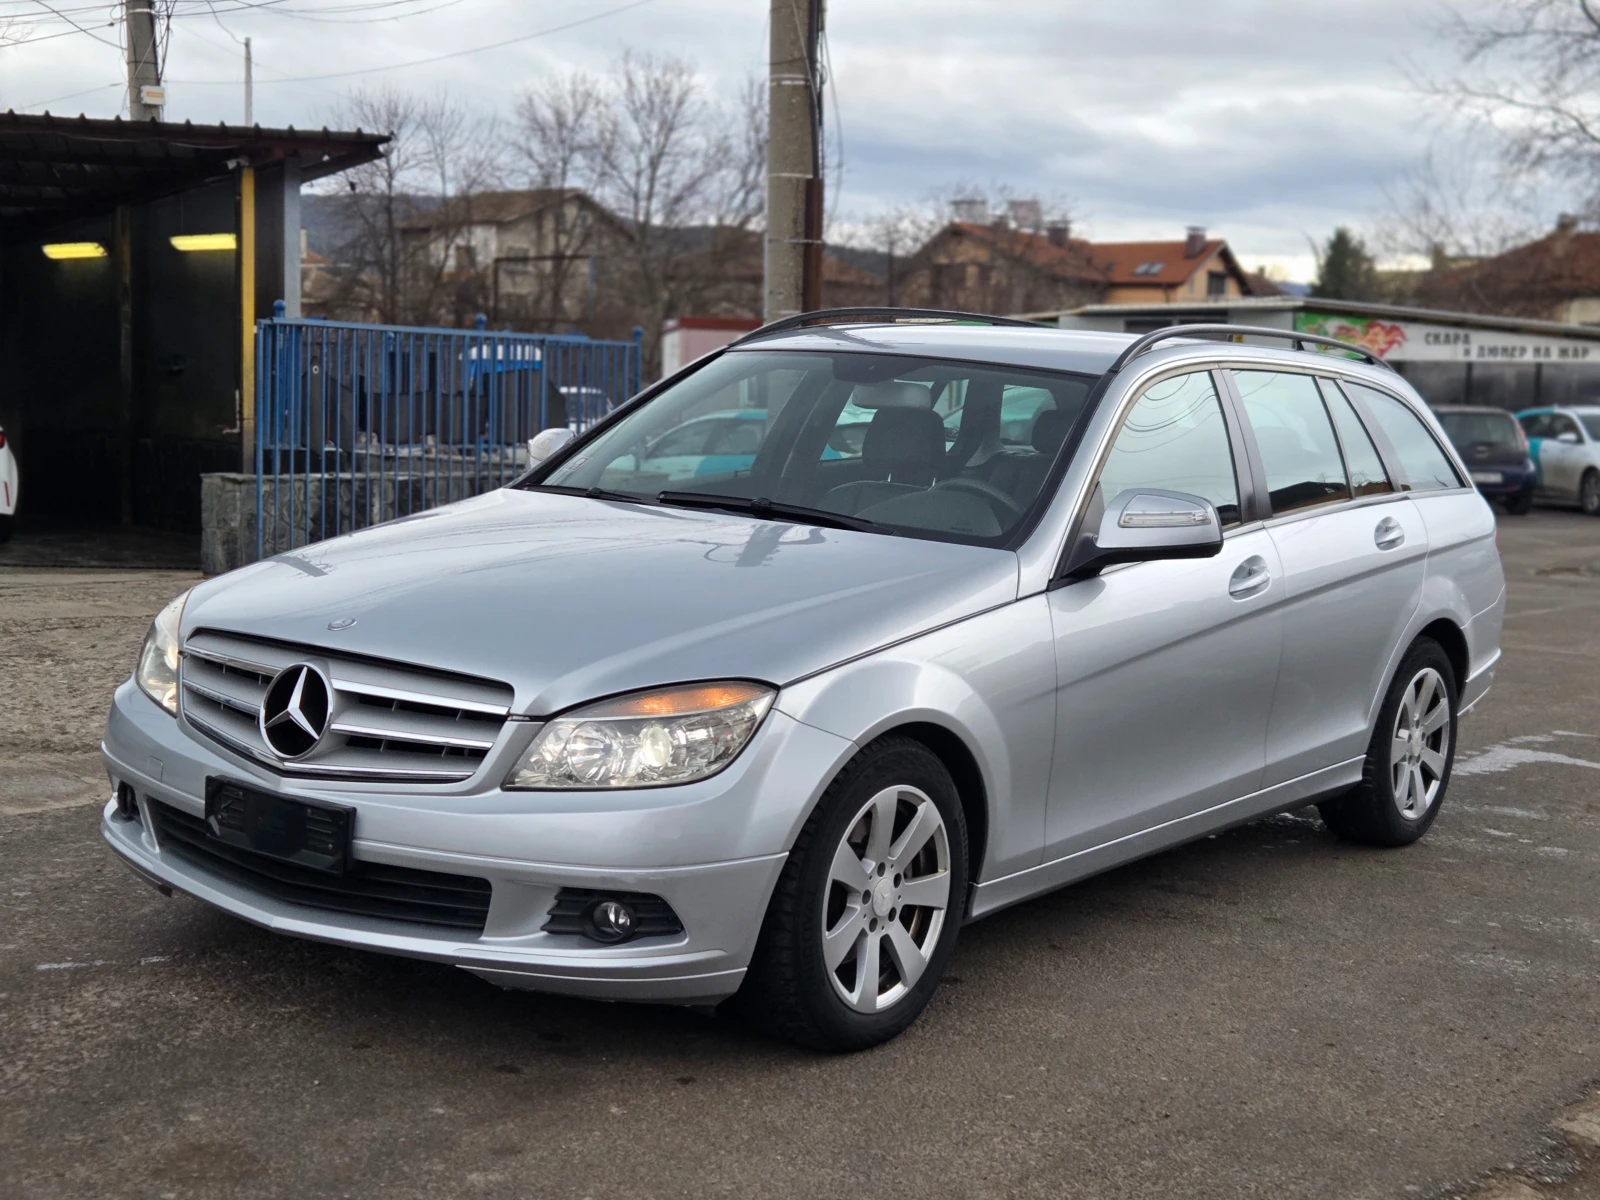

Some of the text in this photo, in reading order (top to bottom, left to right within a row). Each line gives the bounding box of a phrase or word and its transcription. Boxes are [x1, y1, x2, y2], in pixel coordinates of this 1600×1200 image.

[1424, 332, 1470, 345] СКАРА
[1532, 346, 1550, 358] НА
[1558, 346, 1590, 358] ЖАР
